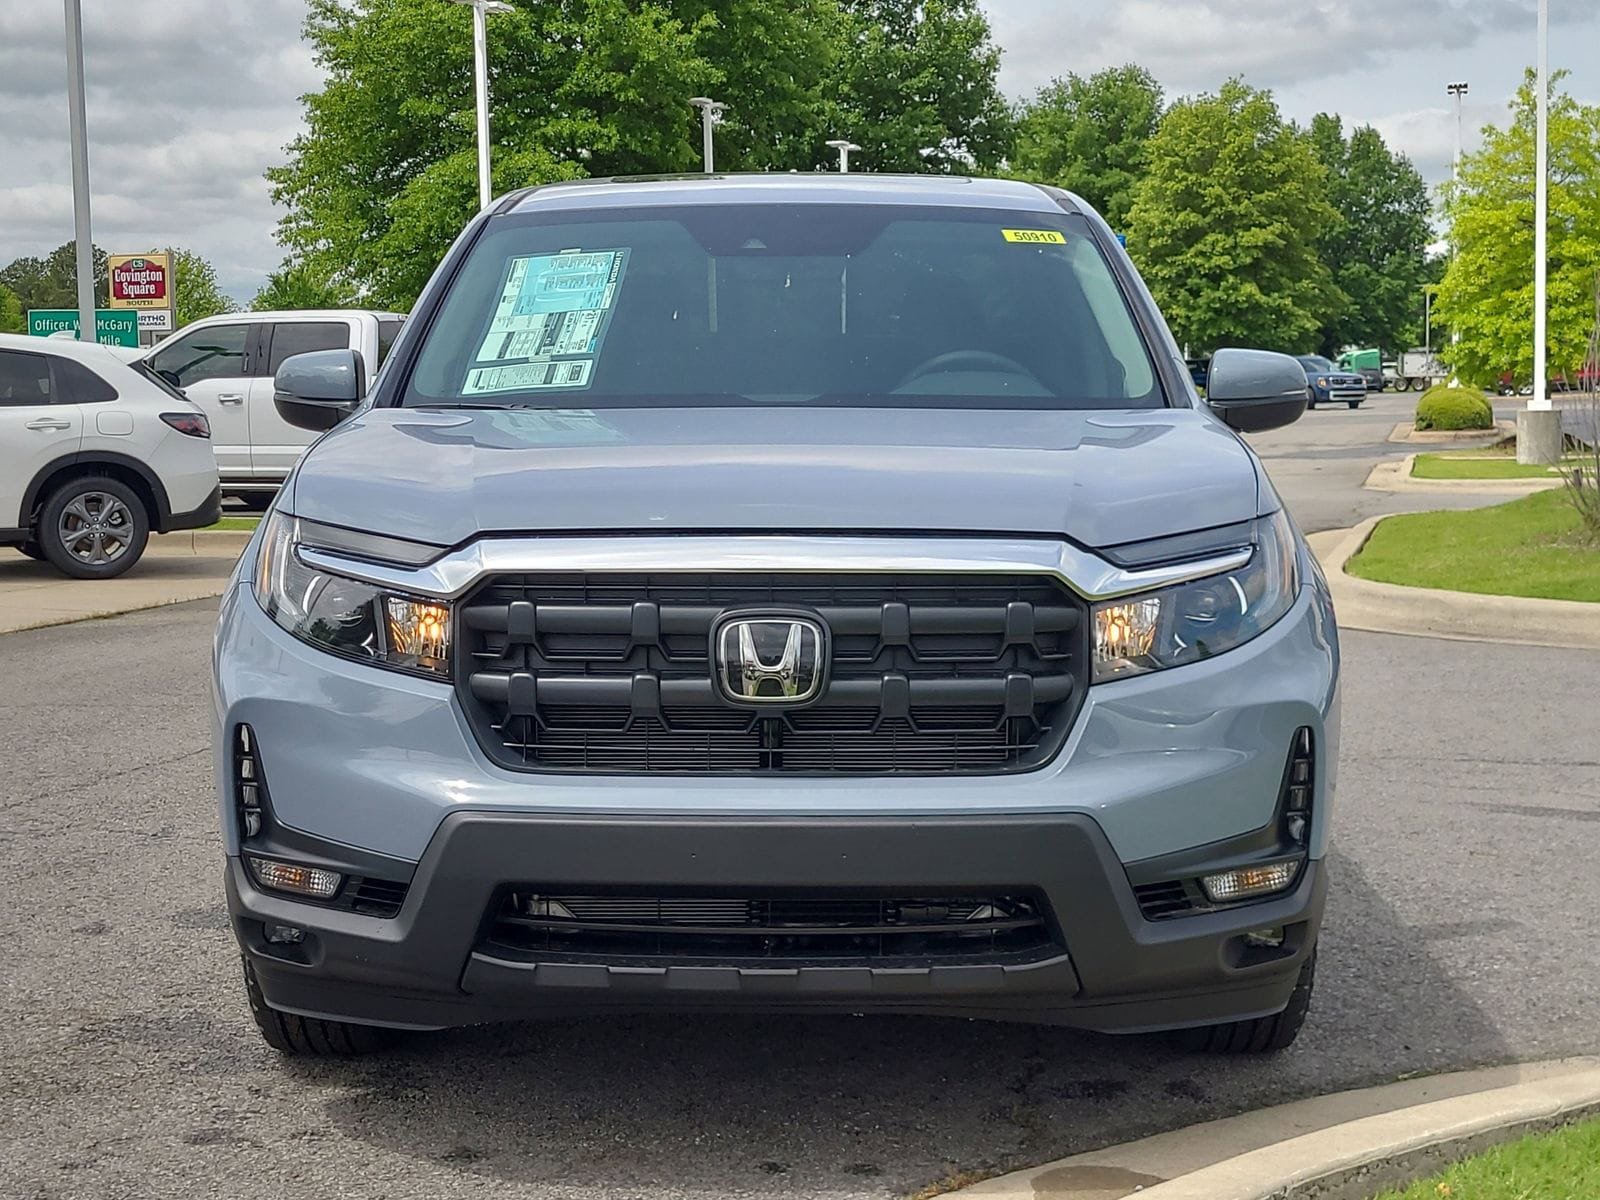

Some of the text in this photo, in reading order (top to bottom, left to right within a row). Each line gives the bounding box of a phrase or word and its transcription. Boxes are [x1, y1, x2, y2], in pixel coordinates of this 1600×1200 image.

[1014, 232, 1057, 242] 50910
[114, 269, 163, 284] Covington
[122, 282, 156, 298] Square
[35, 319, 69, 331] Officer
[97, 319, 133, 333] McGary
[99, 335, 121, 346] Mile
